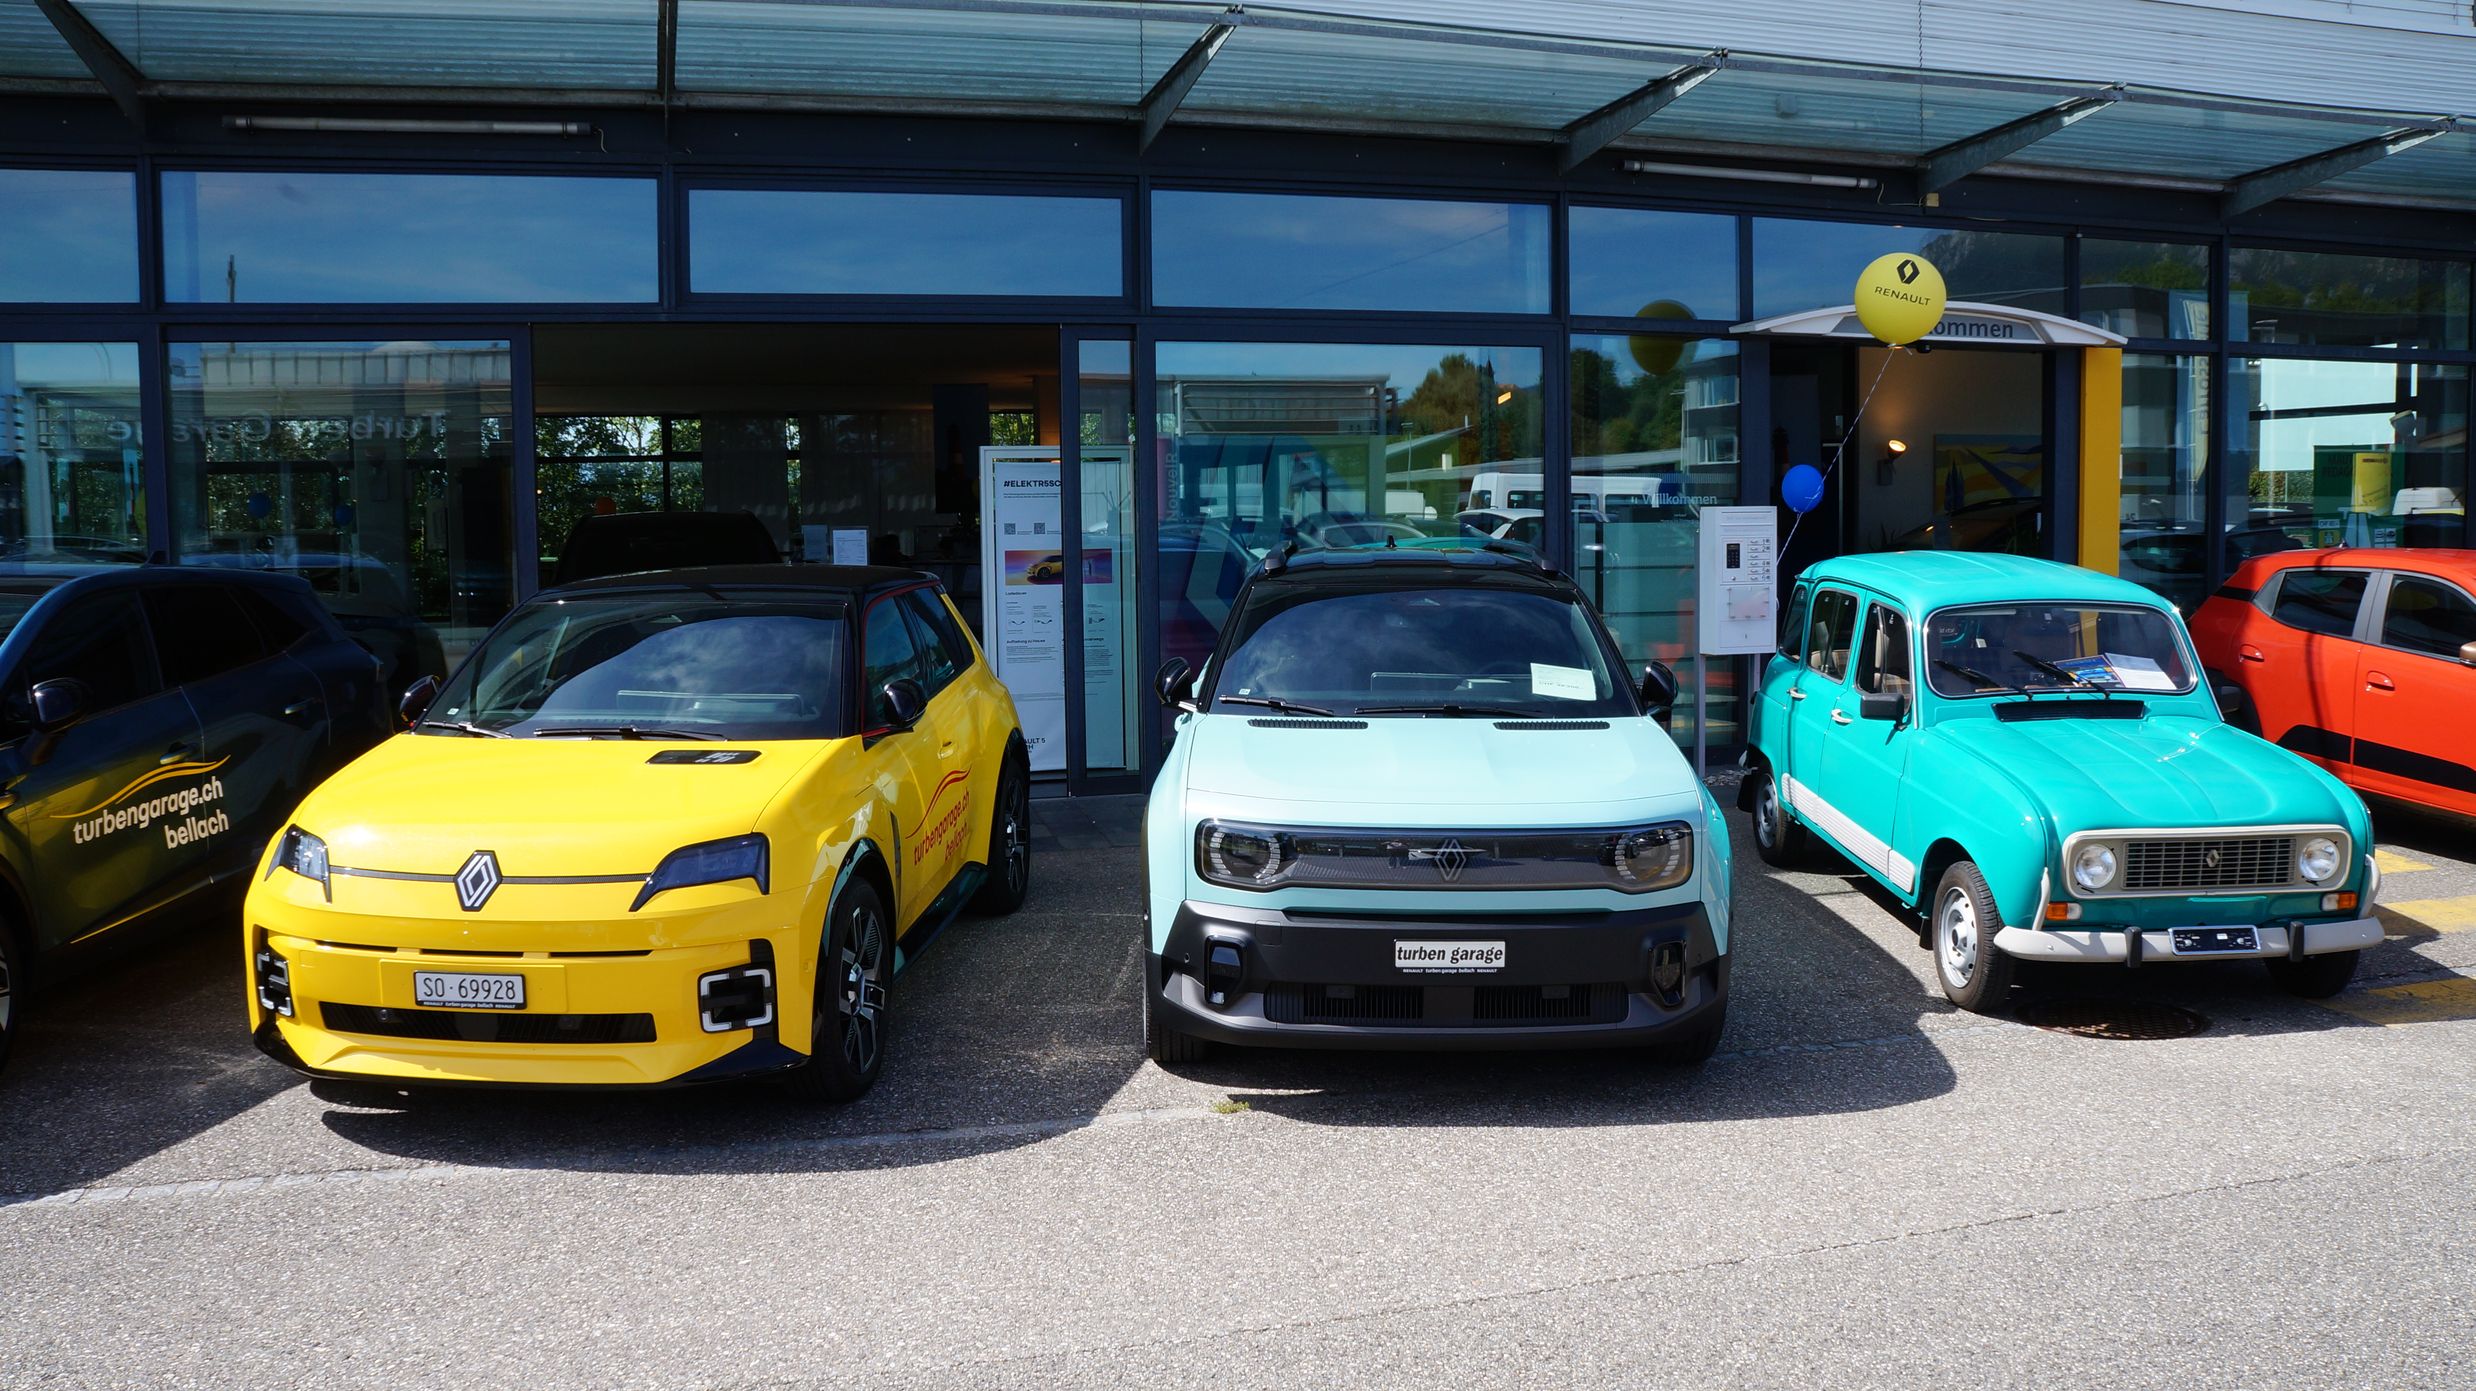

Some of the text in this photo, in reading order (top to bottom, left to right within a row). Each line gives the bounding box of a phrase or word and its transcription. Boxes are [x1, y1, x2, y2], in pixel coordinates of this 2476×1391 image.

[1874, 285, 1931, 306] RENAULT
[1932, 320, 2014, 338] ommen
[1003, 479, 1062, 488] #ELEKTR5SC
[1642, 492, 1718, 505] Willkommen
[72, 775, 224, 845] turbengarage.ch
[164, 808, 229, 850] bellach
[913, 786, 970, 866] turbengarage.ch
[1397, 946, 1503, 964] turben garage
